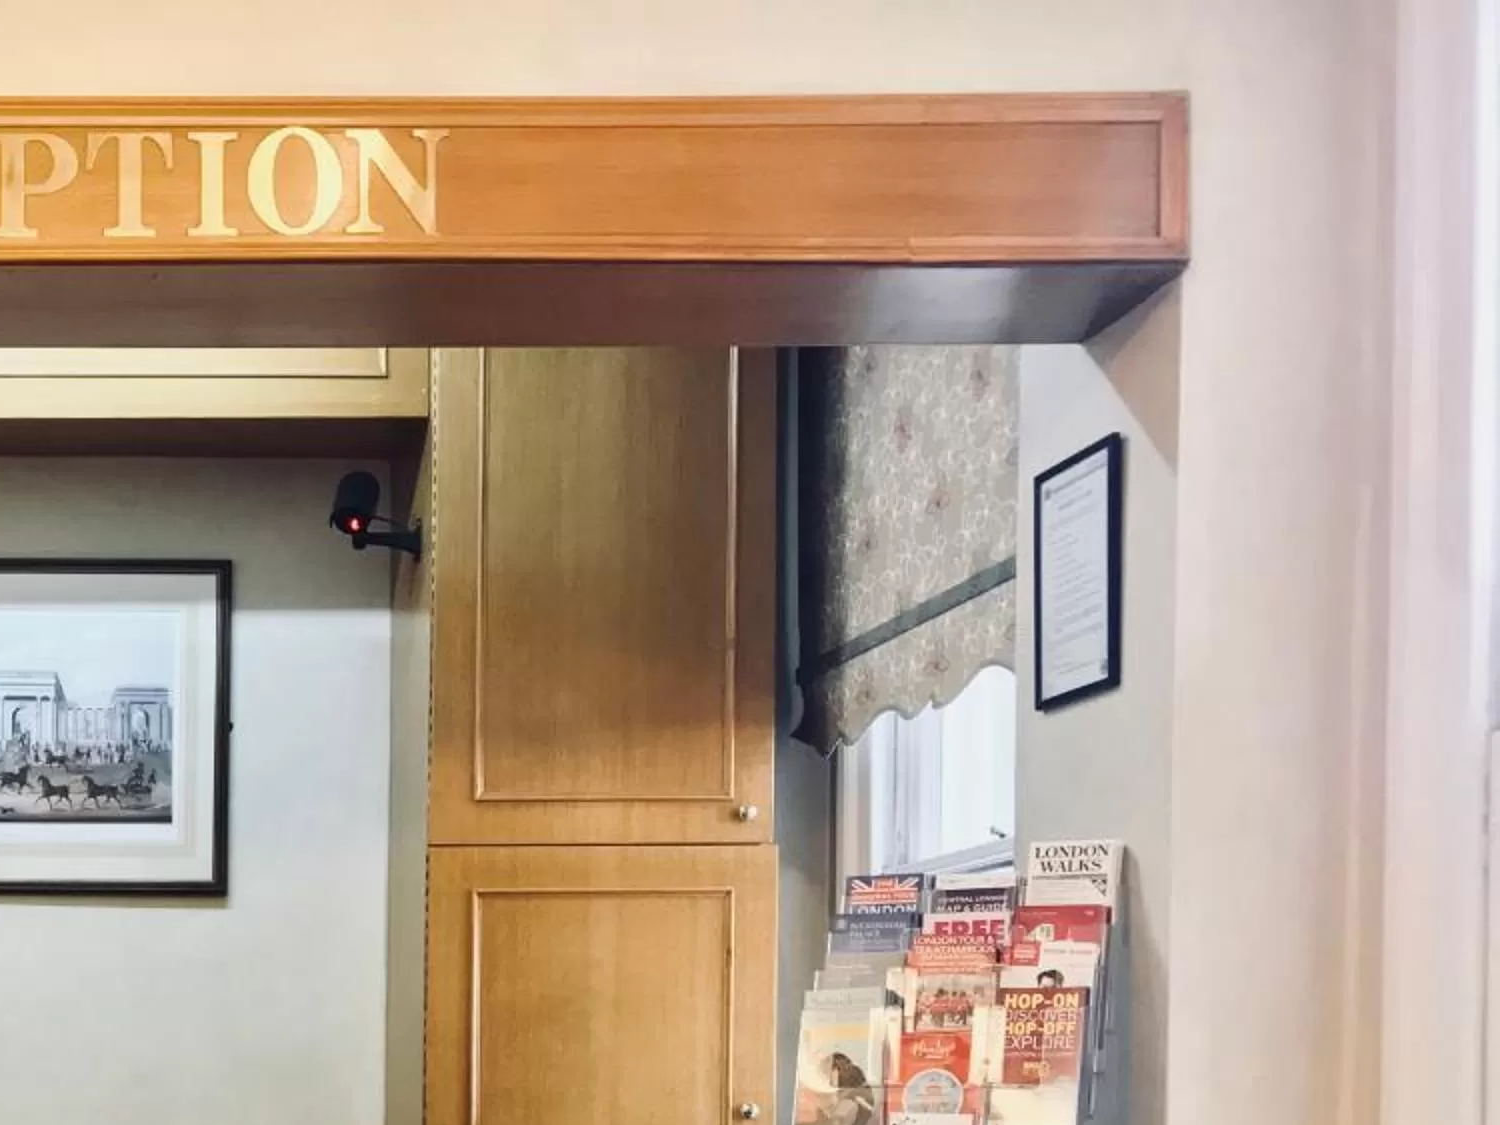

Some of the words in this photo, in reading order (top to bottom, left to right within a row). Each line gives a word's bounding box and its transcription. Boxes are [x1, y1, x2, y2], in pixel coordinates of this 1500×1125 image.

[1035, 844, 1109, 859] LONDON
[1040, 859, 1103, 873] WALKS
[849, 904, 917, 914] LONDON
[934, 920, 1005, 940] FREE
[914, 936, 957, 945] LONDON
[958, 936, 985, 945] TOUR
[1005, 993, 1079, 1009] HOP-ON
[1004, 1009, 1077, 1021] DISCOVER
[1004, 1021, 1077, 1035] HOP-OFF
[1004, 1036, 1075, 1049] EXPLORE
